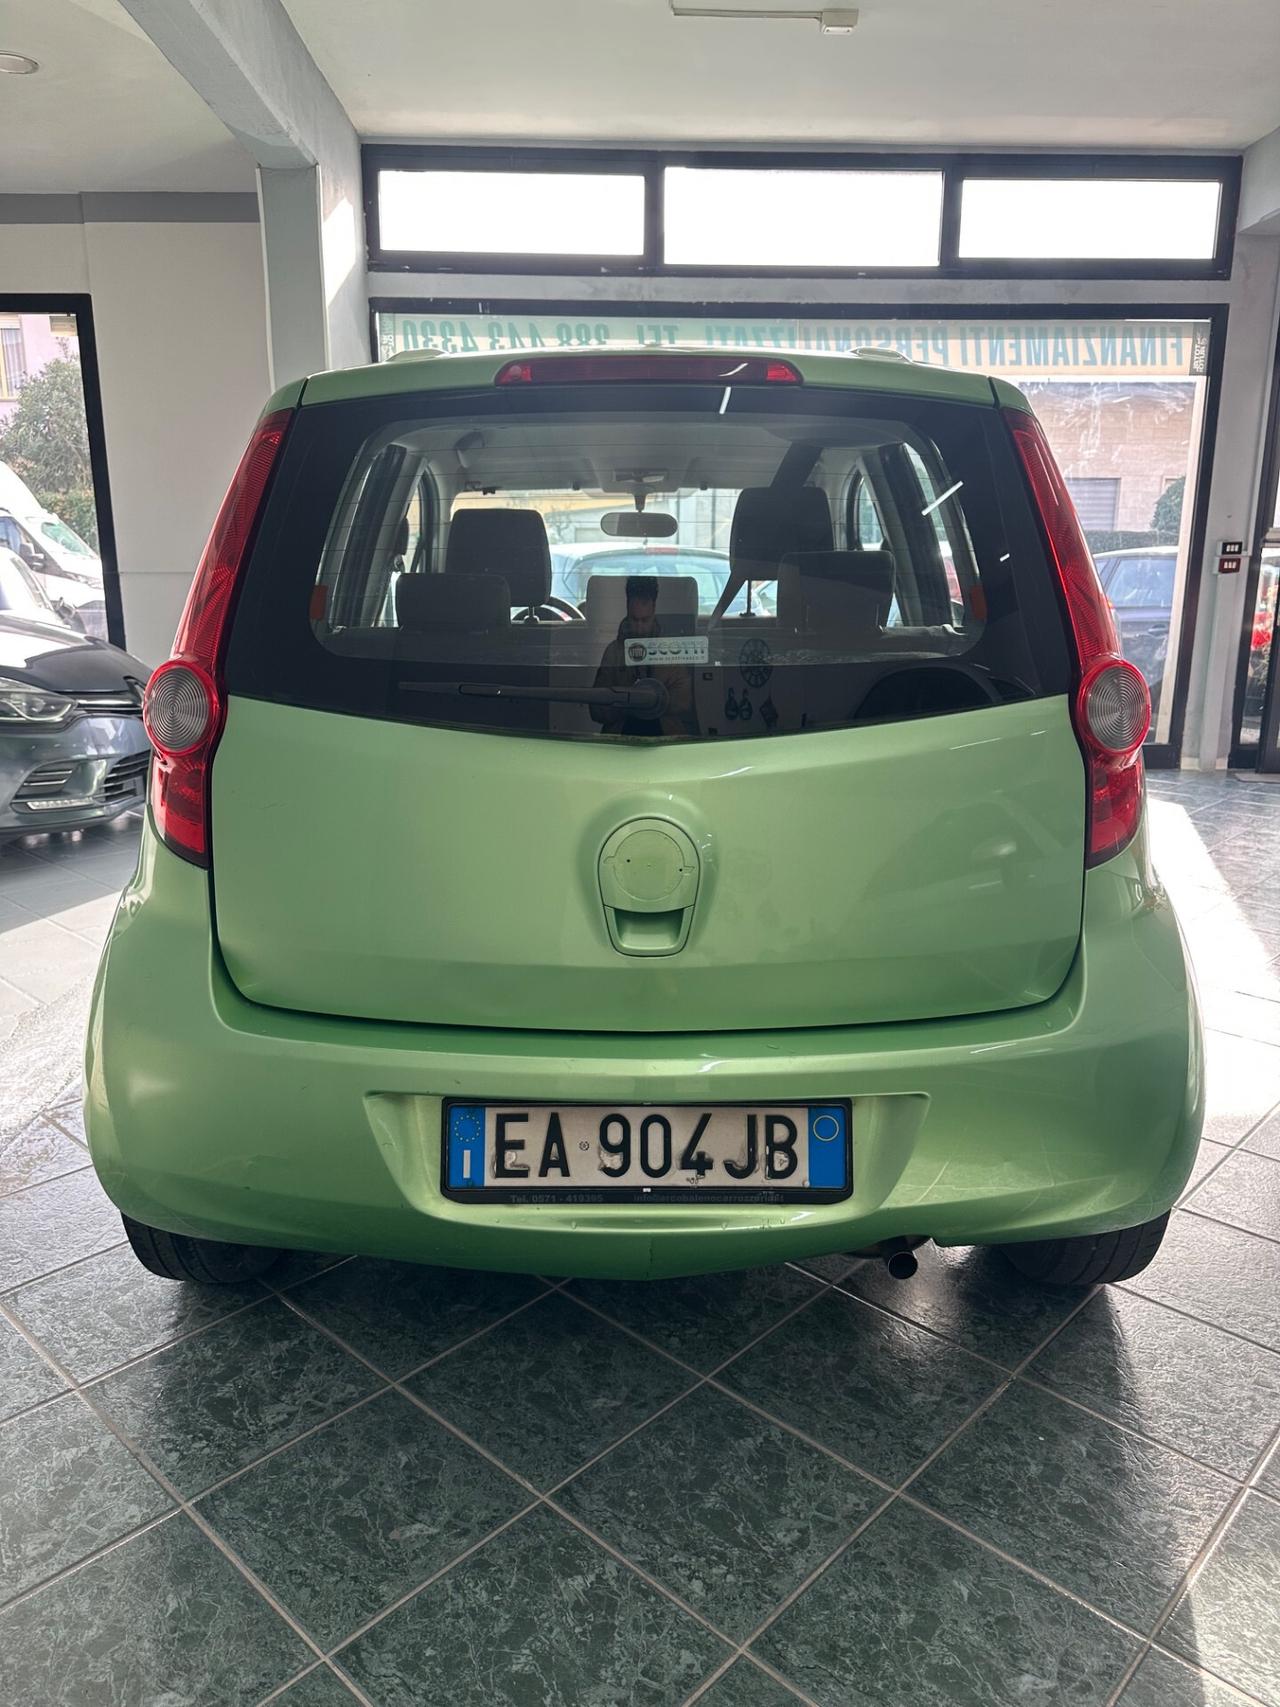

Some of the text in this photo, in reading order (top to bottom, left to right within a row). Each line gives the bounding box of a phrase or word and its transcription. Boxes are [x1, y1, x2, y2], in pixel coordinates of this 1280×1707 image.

[495, 1112, 798, 1180] EA 904 JB
